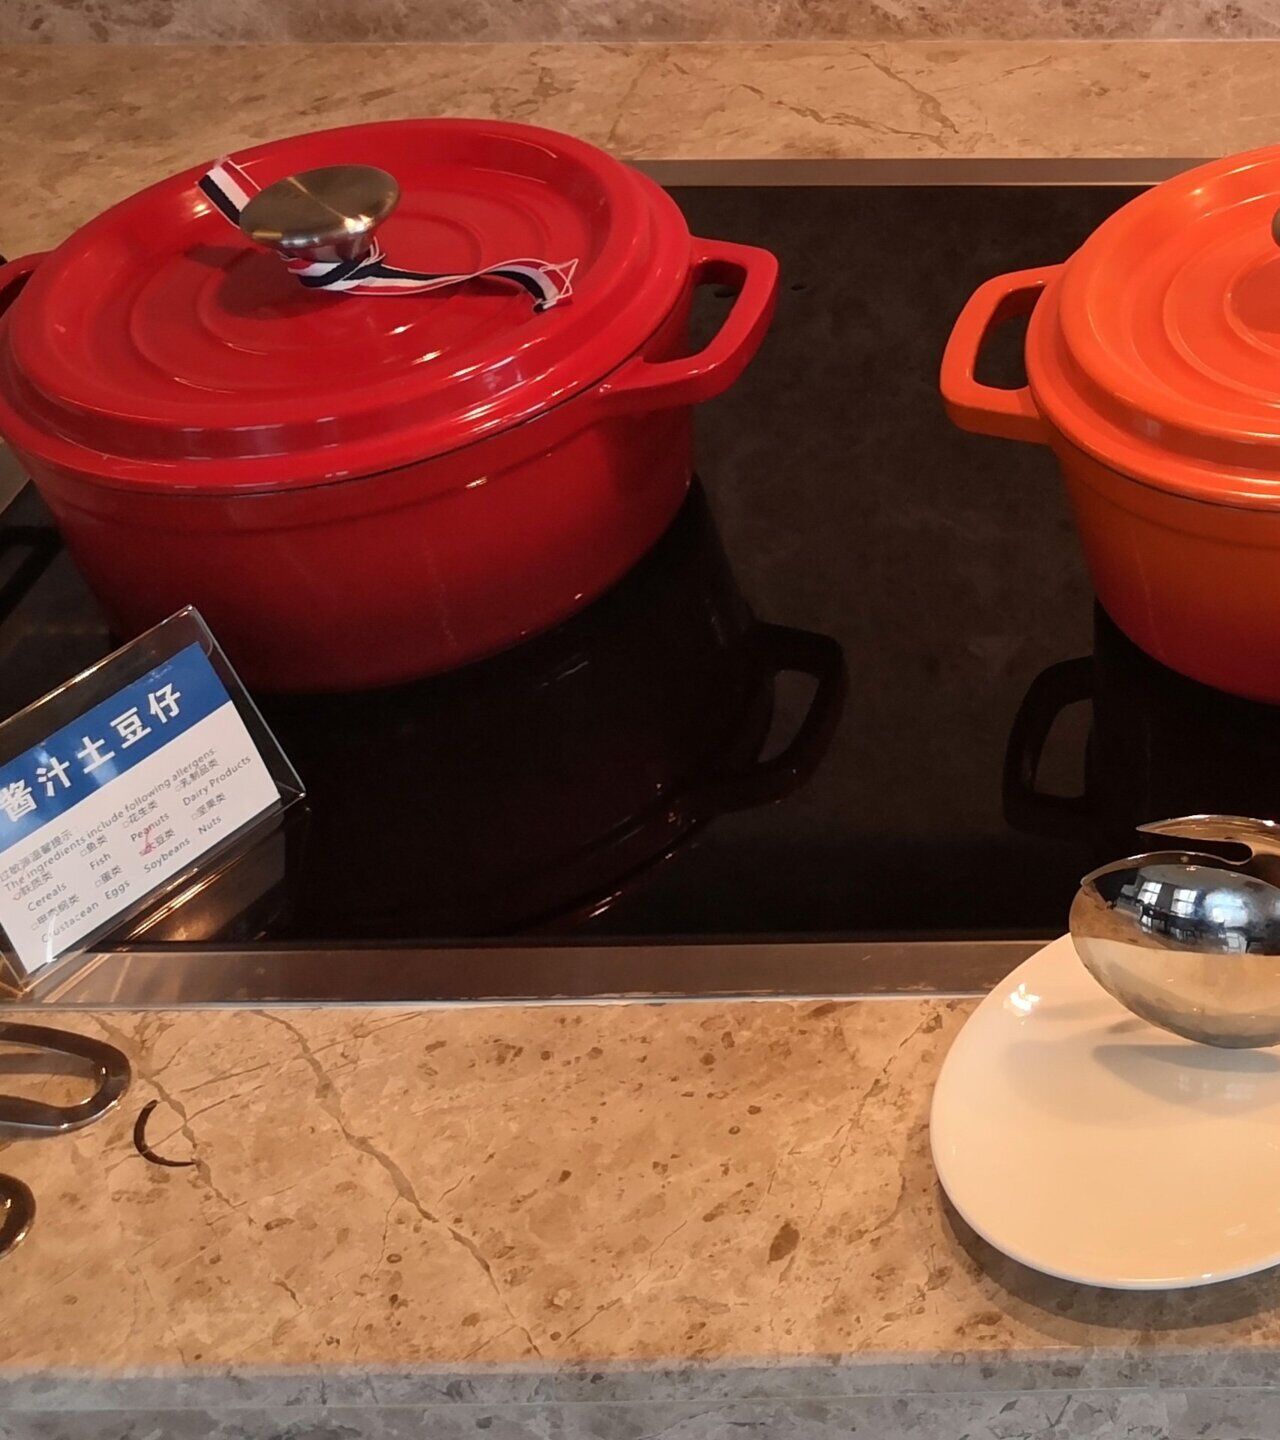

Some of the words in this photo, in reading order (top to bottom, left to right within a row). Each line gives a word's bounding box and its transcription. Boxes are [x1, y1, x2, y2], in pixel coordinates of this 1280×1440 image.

[0, 682, 181, 822] 酱汁土豆仔
[3, 876, 25, 892] The
[26, 837, 87, 879] ingredients
[87, 810, 124, 839] include
[124, 779, 172, 813] following
[27, 882, 68, 912] Cereals
[89, 852, 112, 871] Fish
[130, 812, 170, 842] Peanuts
[182, 785, 209, 806] Dairy
[208, 755, 252, 788] Products
[41, 901, 100, 944] Custacean
[104, 879, 131, 901] Eggs
[143, 837, 191, 874] Soybeans
[197, 815, 222, 835] Nuts
